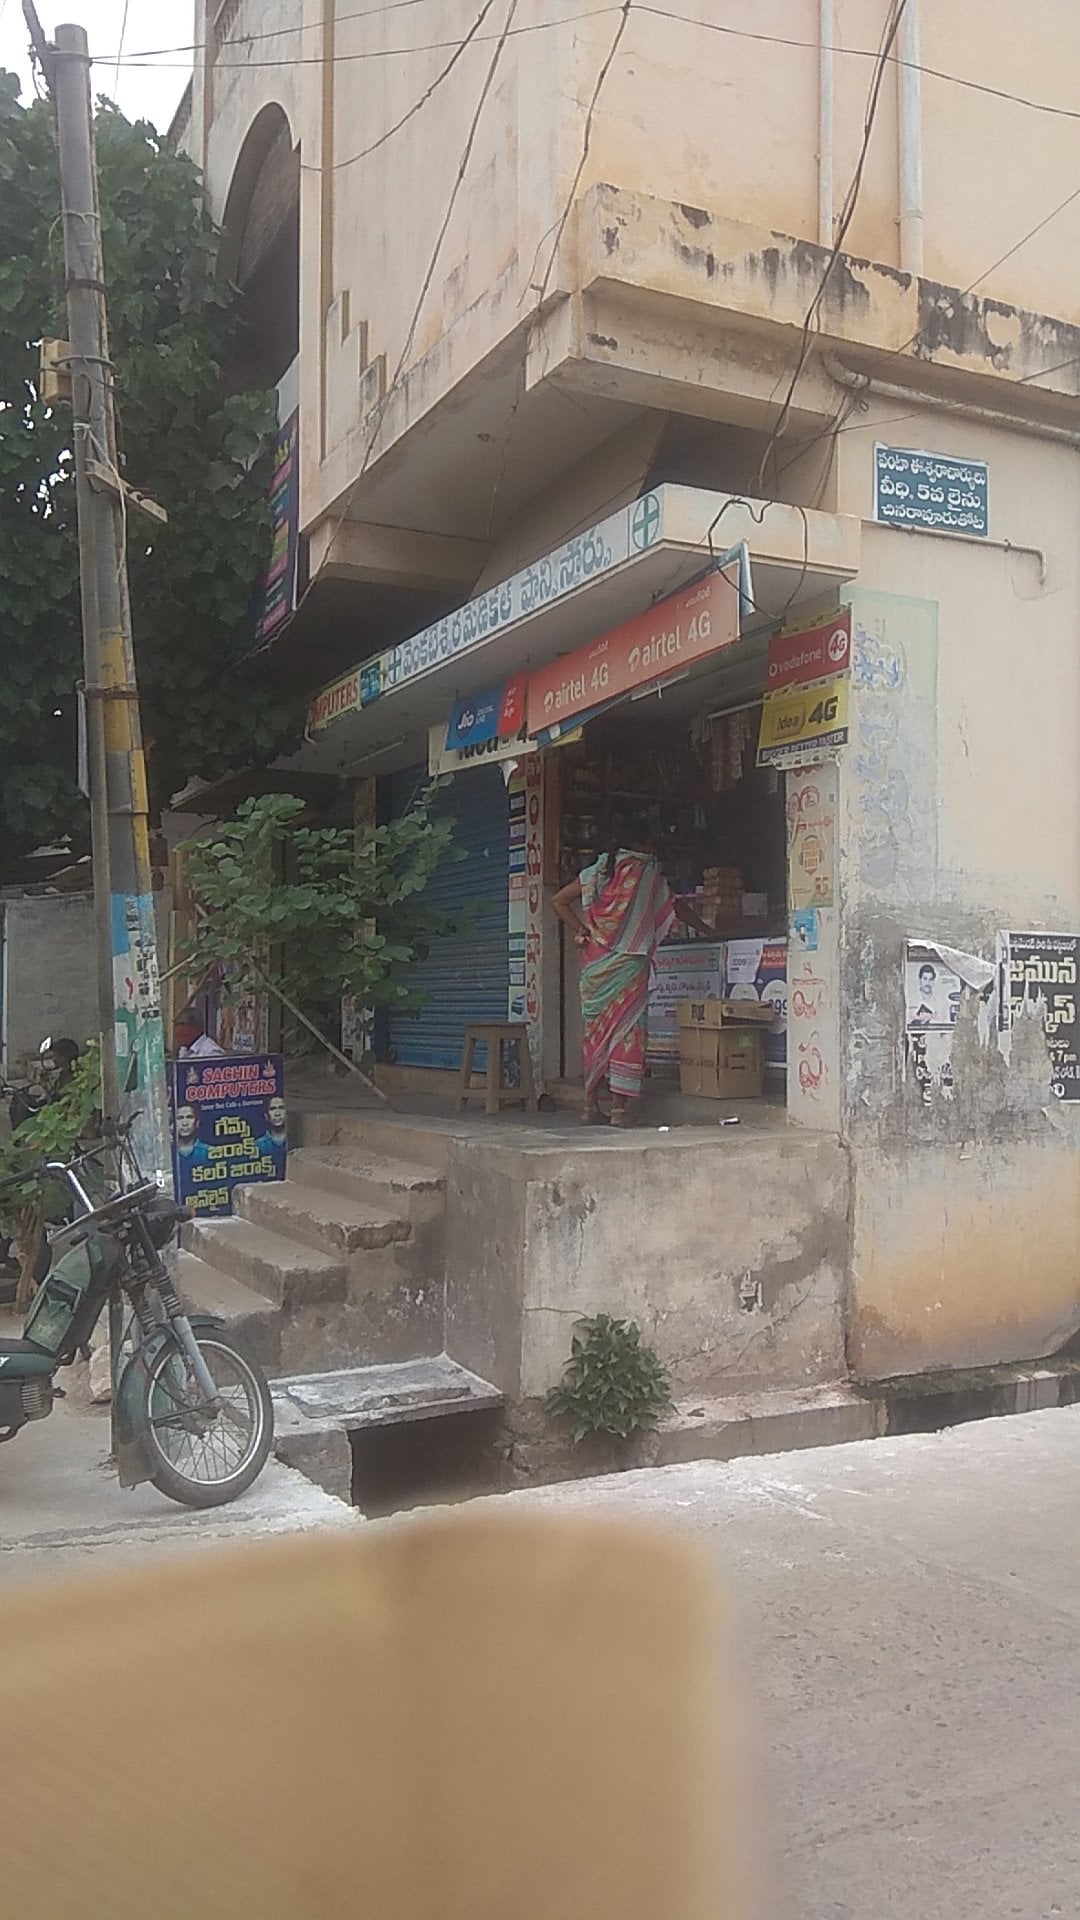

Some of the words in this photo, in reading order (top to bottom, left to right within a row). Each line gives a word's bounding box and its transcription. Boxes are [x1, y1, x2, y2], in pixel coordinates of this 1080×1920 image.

[642, 625, 681, 667] airtel
[687, 610, 711, 642] 4G
[829, 634, 847, 655] 4G
[779, 648, 822, 672] vodafone
[554, 674, 586, 708] airtel
[590, 662, 609, 691] 4G
[457, 710, 475, 730] Jio
[808, 695, 839, 725] 4G
[202, 1064, 260, 1084] SACHIN
[185, 1078, 276, 1102] COMPUTERS
